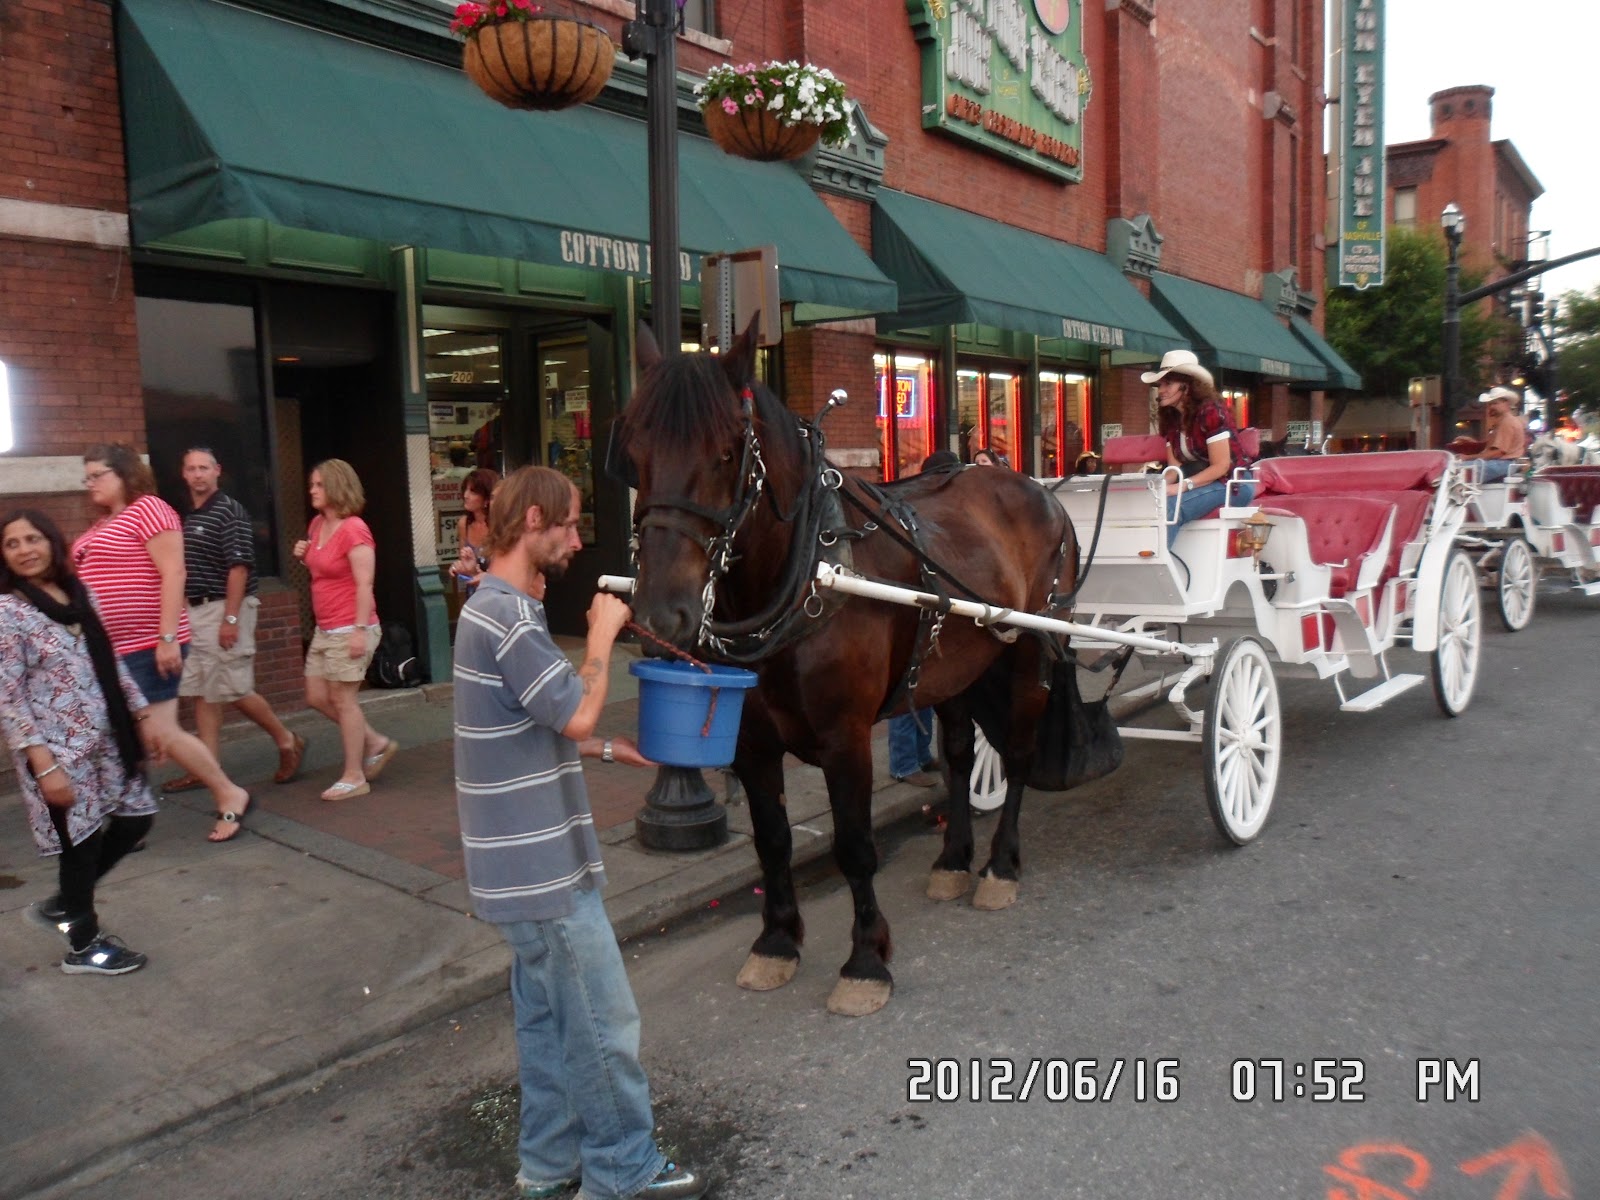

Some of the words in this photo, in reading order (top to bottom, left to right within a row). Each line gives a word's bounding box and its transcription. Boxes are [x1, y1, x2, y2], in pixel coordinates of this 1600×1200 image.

[1356, 221, 1368, 231] OF
[1344, 232, 1381, 241] NASHVILLE
[560, 230, 639, 273] COTTON
[453, 372, 473, 382] 200
[434, 483, 459, 492] PLEASE
